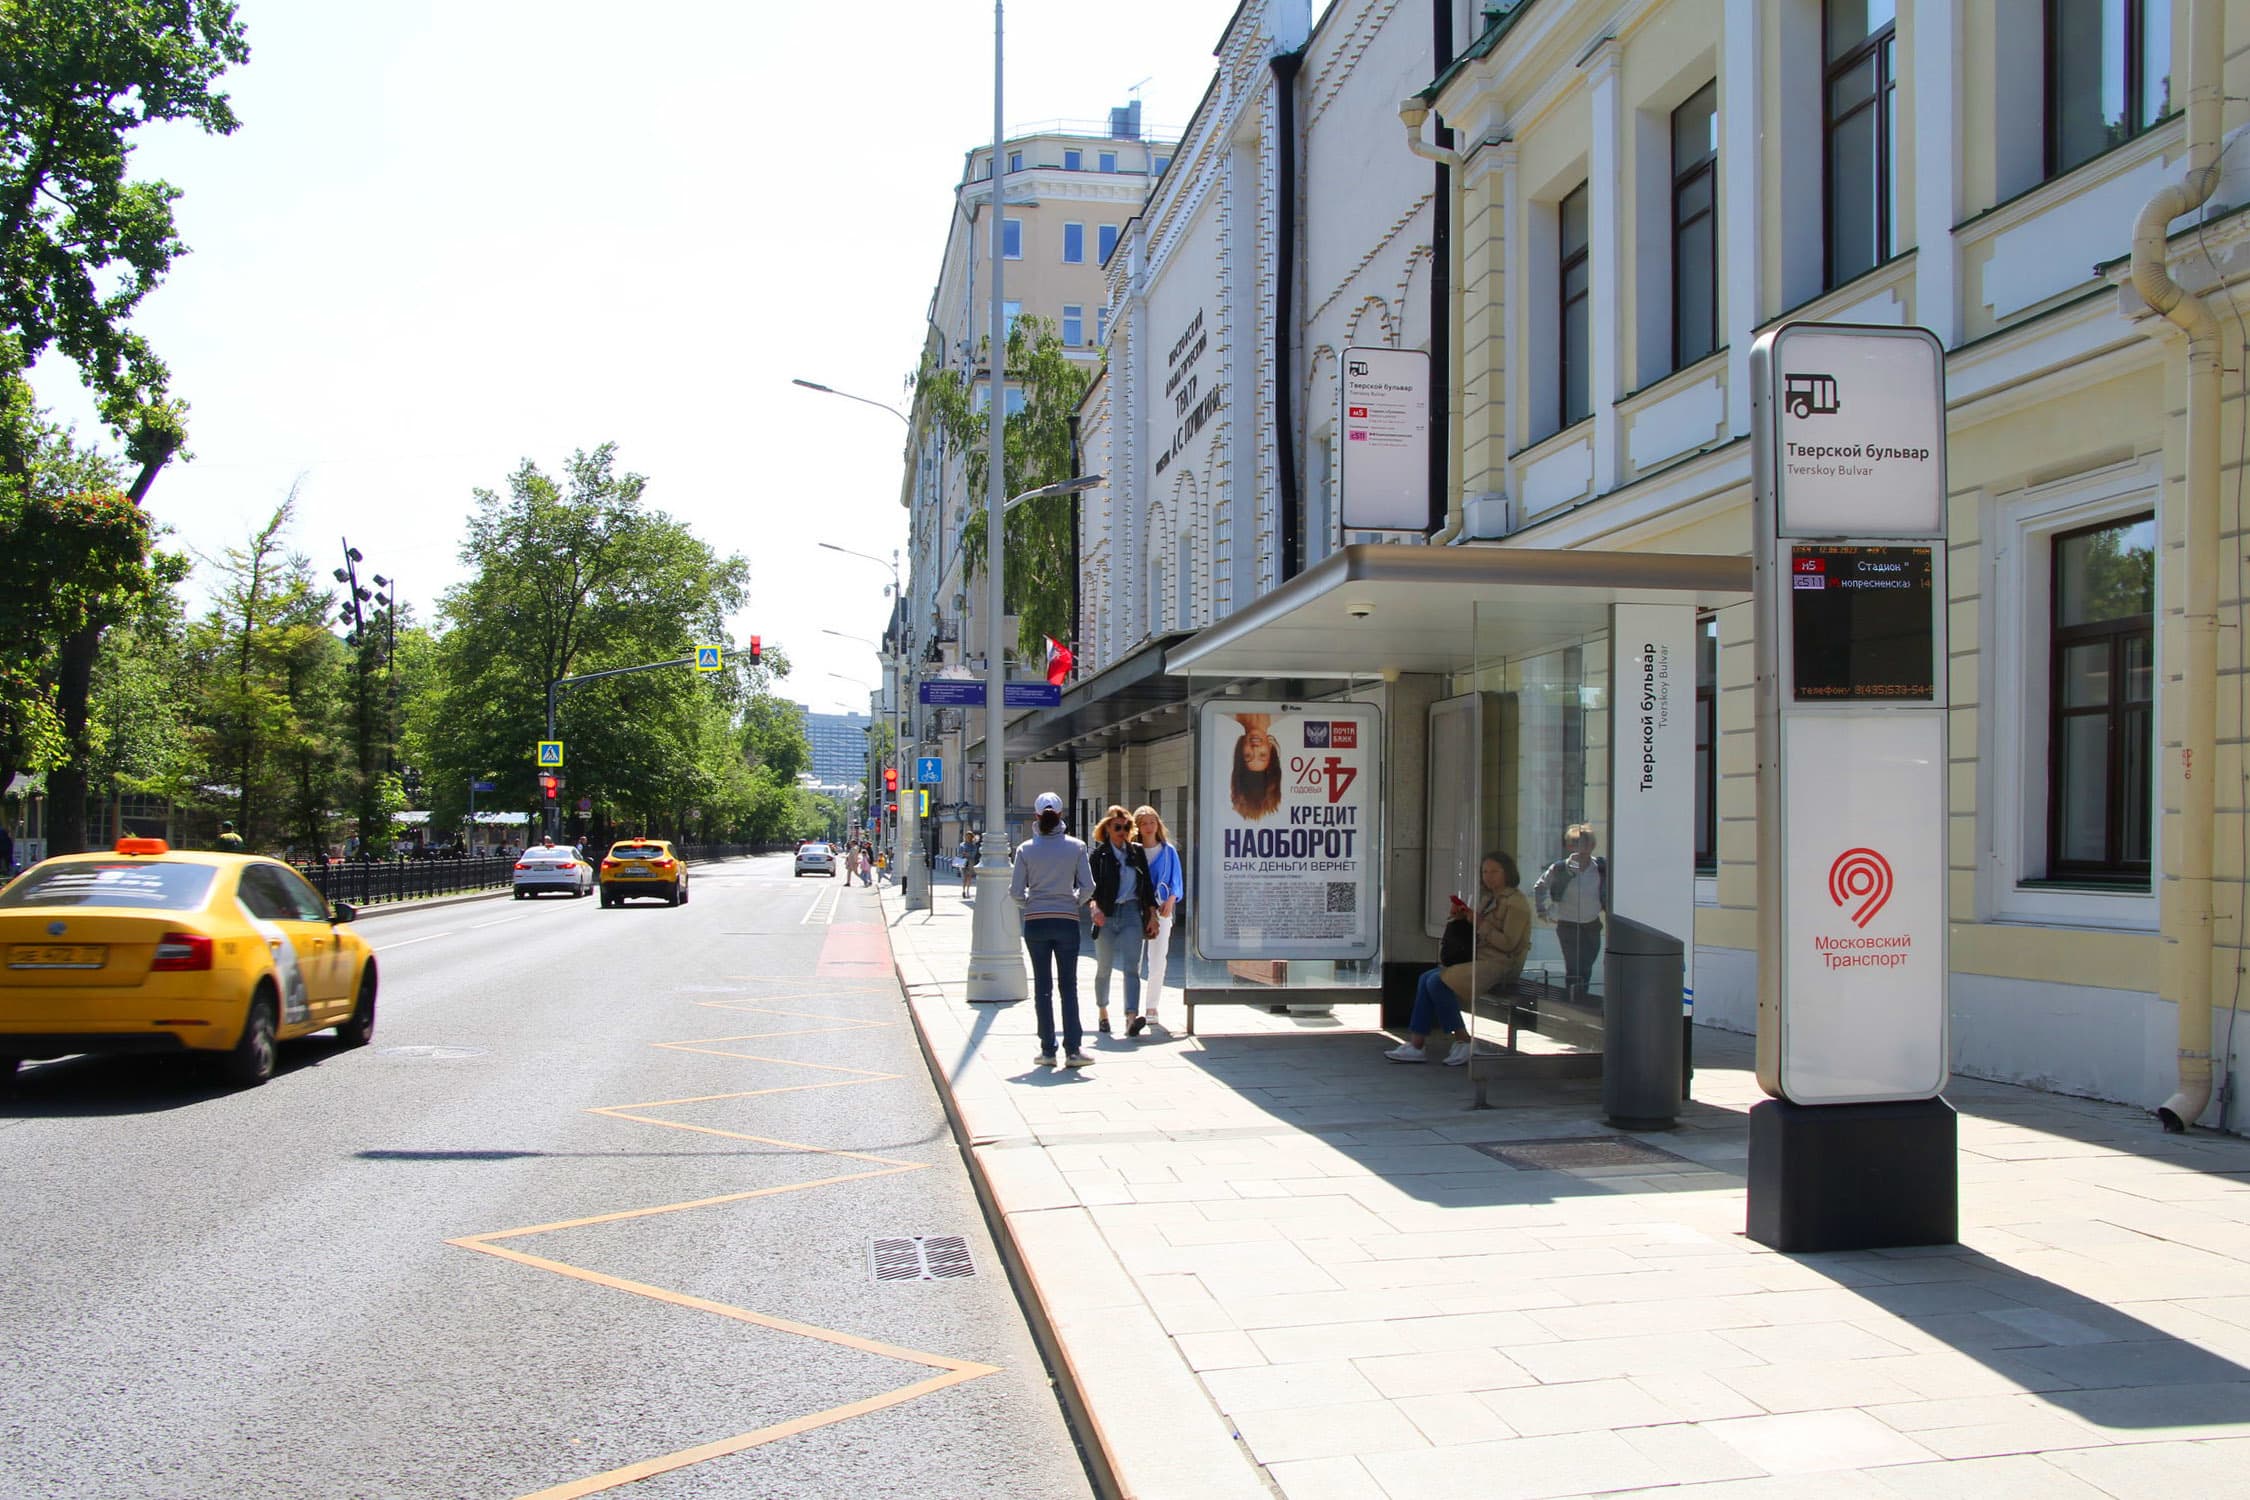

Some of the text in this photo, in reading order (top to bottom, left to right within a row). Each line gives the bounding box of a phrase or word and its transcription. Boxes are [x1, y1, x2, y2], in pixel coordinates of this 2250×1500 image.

[1350, 382, 1382, 390] Тверской
[1175, 374, 1197, 418] ТЕАТР
[1787, 442, 1929, 460] Тверской бульвар
[1787, 464, 1872, 478] Tverskoy Bulvar
[1858, 561, 1901, 572] Стадион
[1659, 646, 1670, 728] Tverskoy Bulvar
[1640, 643, 1656, 792] Тверской бульвар
[1290, 806, 1356, 826] КРЕДИТ
[1224, 828, 1356, 858] НАОБОРОТ
[1224, 862, 1256, 872] БАНК
[1259, 862, 1308, 873] ДЕНЬГИ
[1815, 934, 1911, 949] Московский
[1823, 953, 1907, 970] Транспорт
